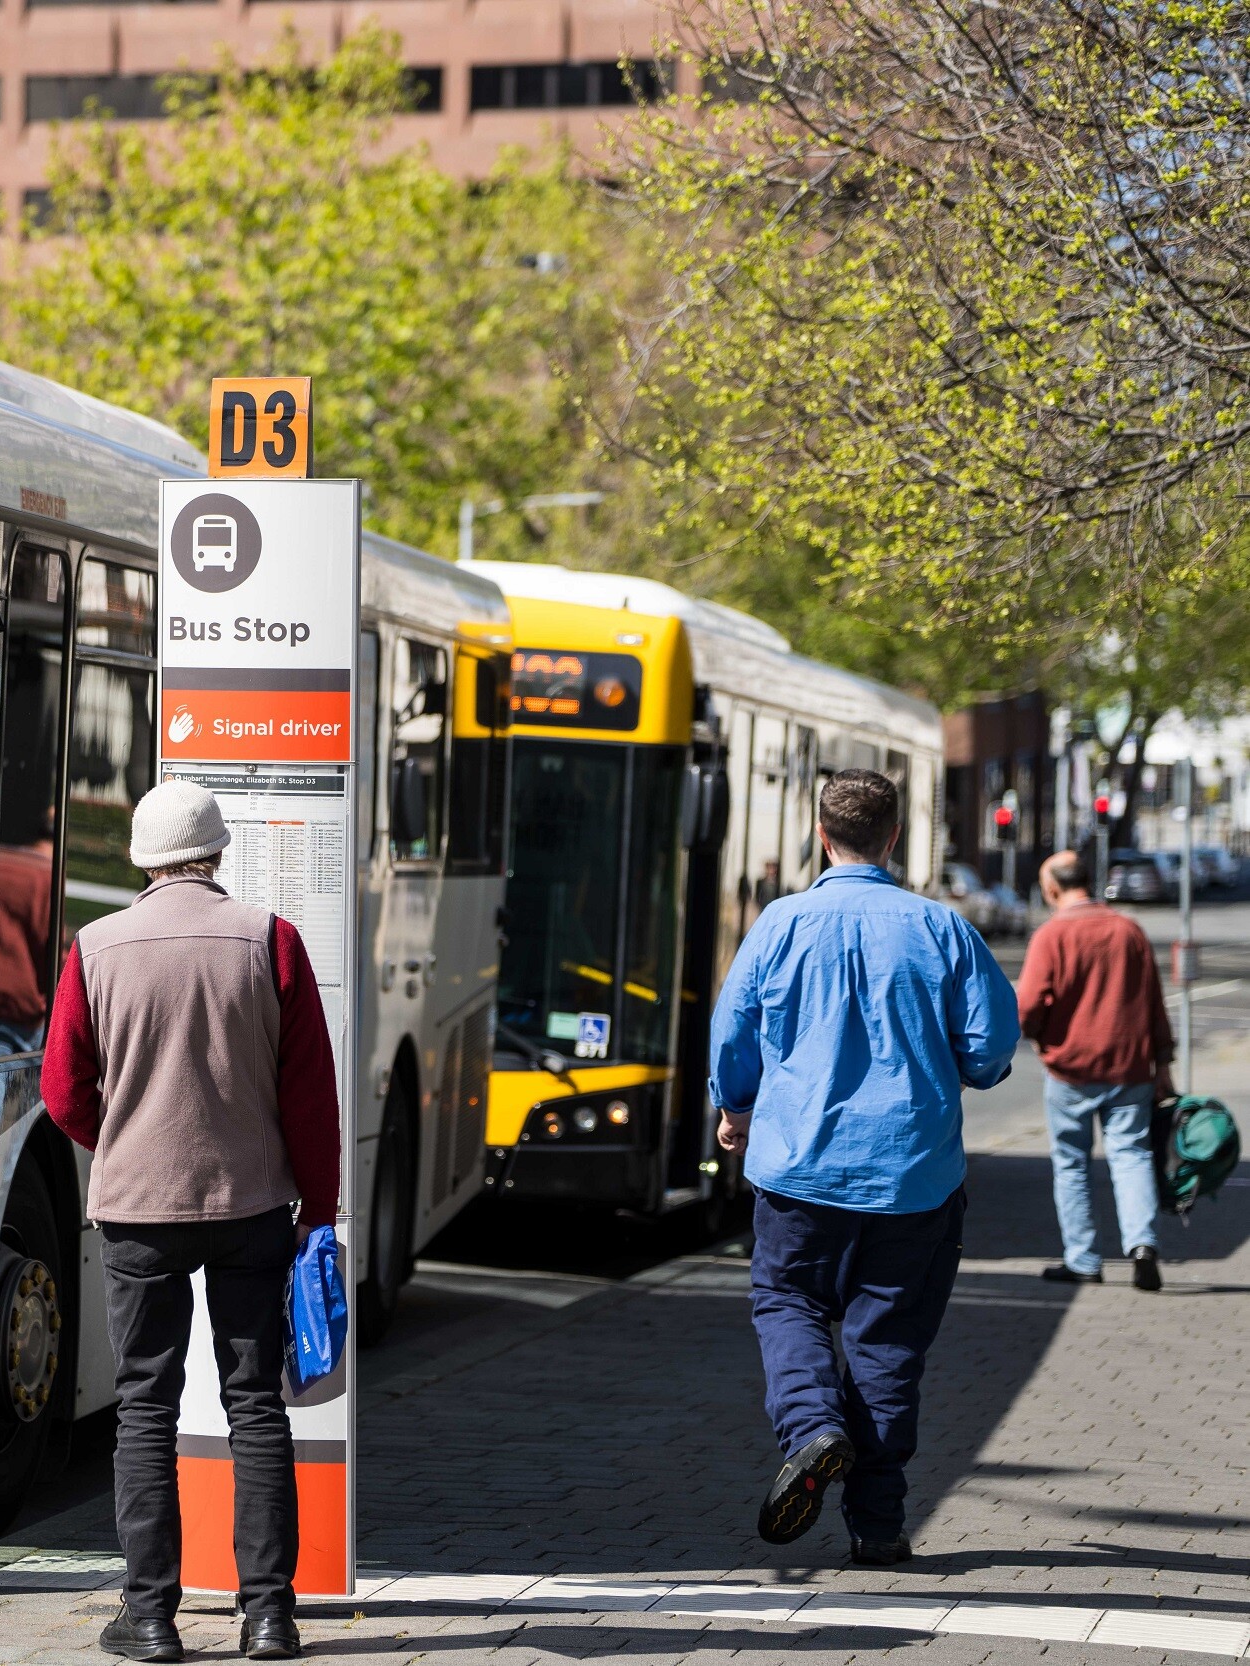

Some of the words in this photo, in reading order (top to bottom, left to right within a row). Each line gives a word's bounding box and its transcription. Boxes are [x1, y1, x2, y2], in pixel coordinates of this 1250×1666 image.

[220, 390, 298, 468] D3
[168, 616, 222, 641] Bus
[232, 616, 311, 648] Stop
[212, 718, 274, 738] Signal
[279, 718, 342, 738] driver
[182, 774, 204, 783] Hobart
[205, 775, 245, 785] Interchange,
[246, 776, 277, 785] Elizabeth
[288, 778, 305, 787] Stop
[306, 778, 317, 786] D3
